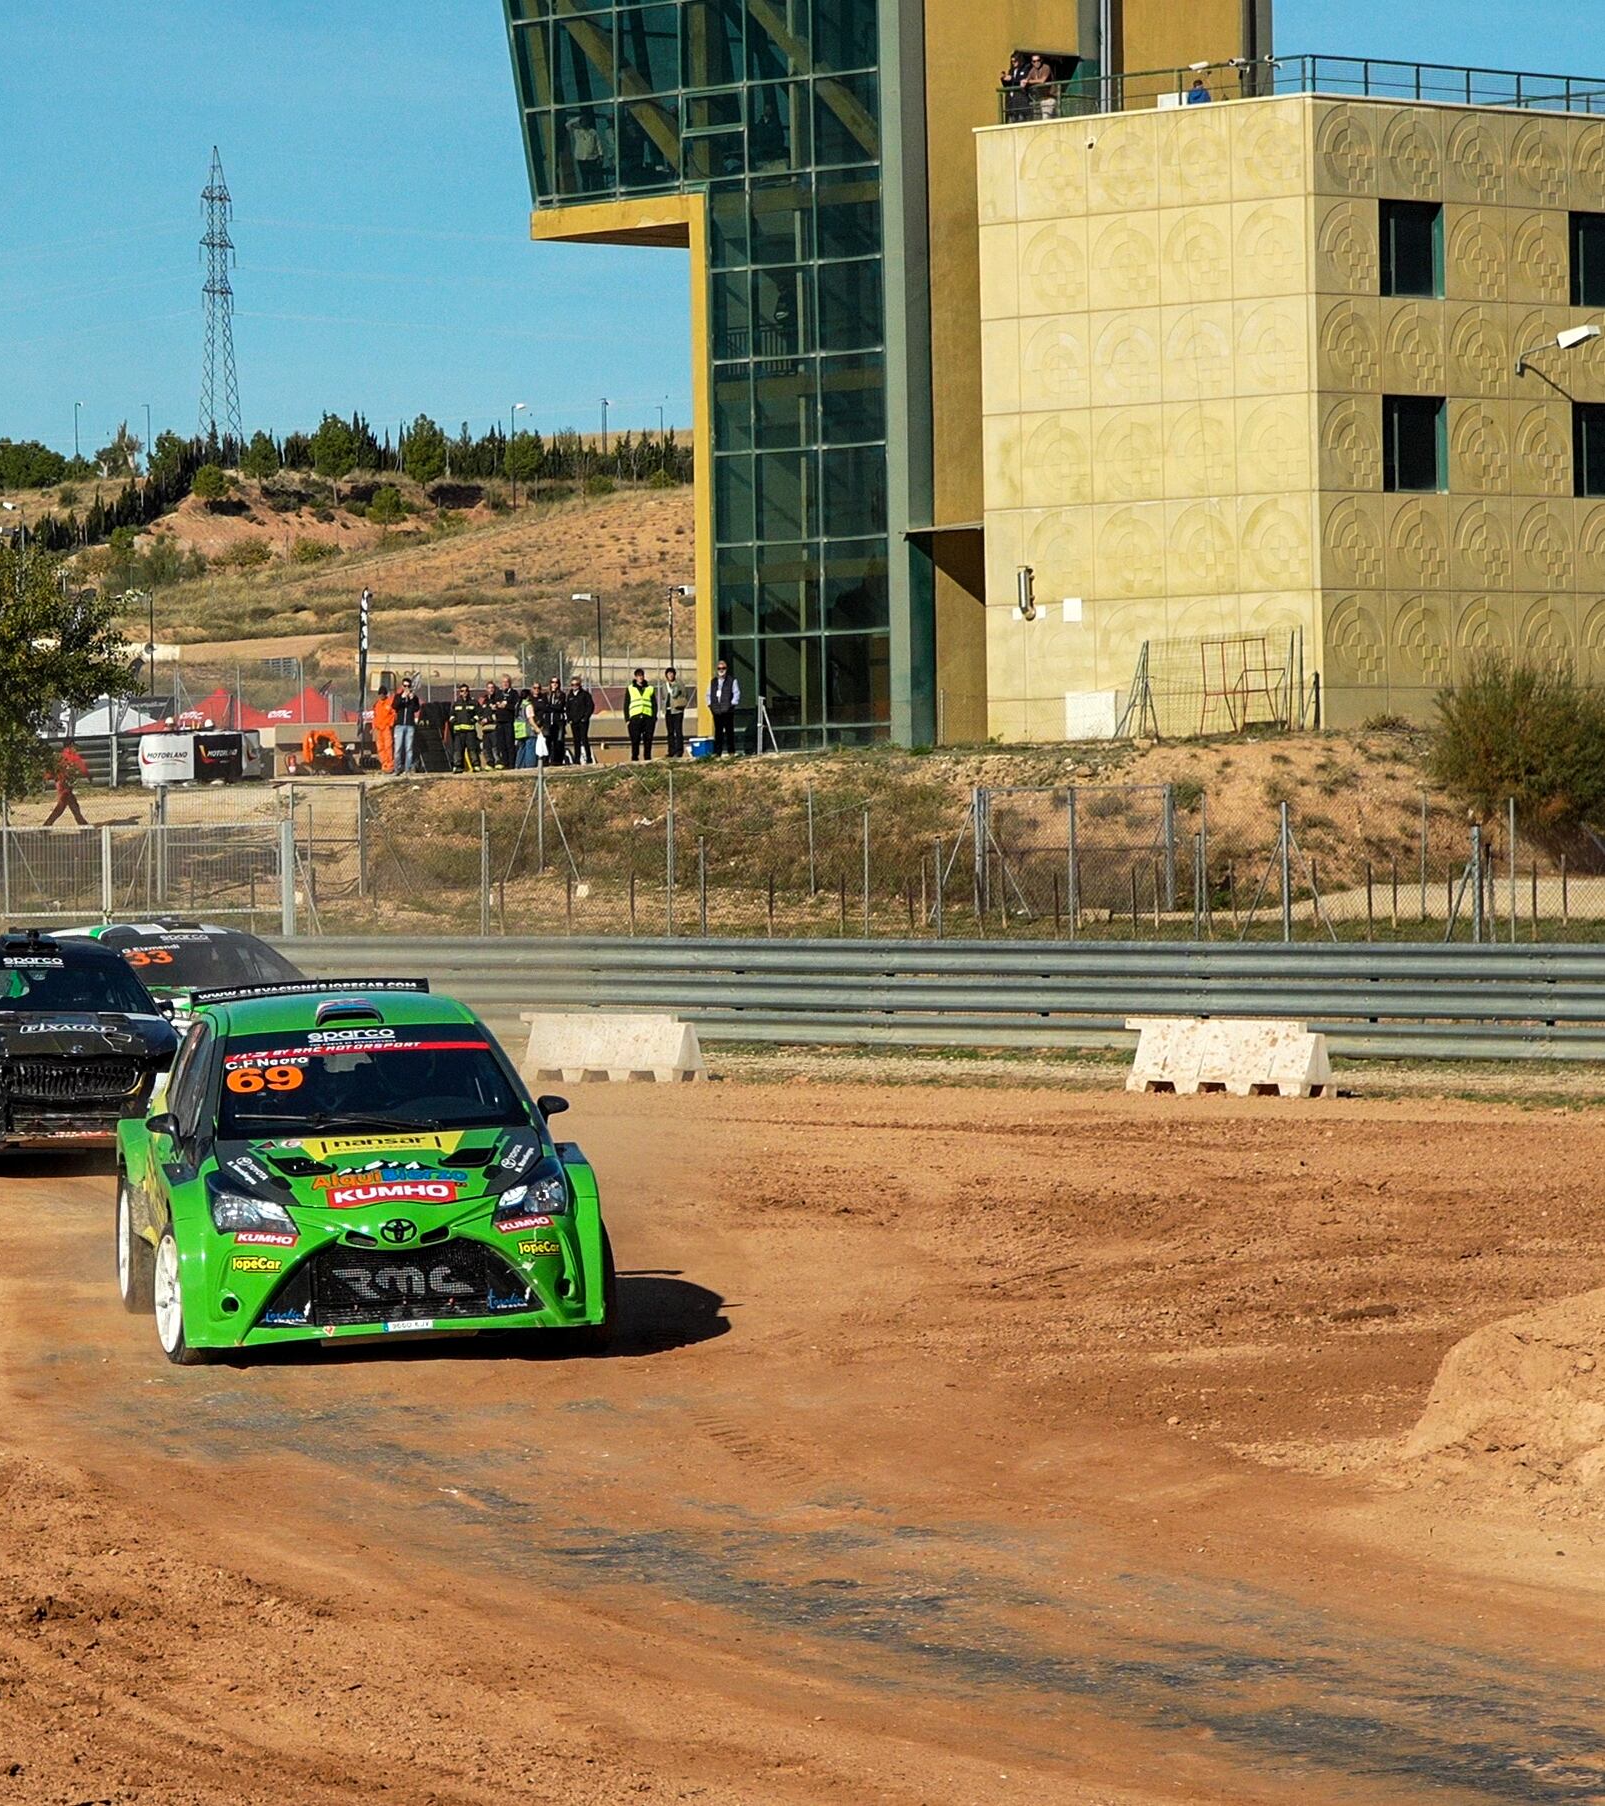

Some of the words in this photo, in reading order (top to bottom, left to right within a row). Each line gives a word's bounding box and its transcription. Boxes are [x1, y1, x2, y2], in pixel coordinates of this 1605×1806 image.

[146, 751, 188, 760] MOTORLAND
[3, 957, 63, 965] sparco
[123, 950, 174, 967] 33
[307, 1029, 395, 1042] sparco
[325, 1041, 422, 1052] MOTORSPORT
[226, 1065, 304, 1093] 69
[333, 1136, 427, 1147] nansar
[312, 1168, 469, 1189] AlquiBierzo
[335, 1184, 449, 1203] KUMHO
[499, 1216, 550, 1232] KUMHO
[237, 1233, 294, 1244] KUMHO
